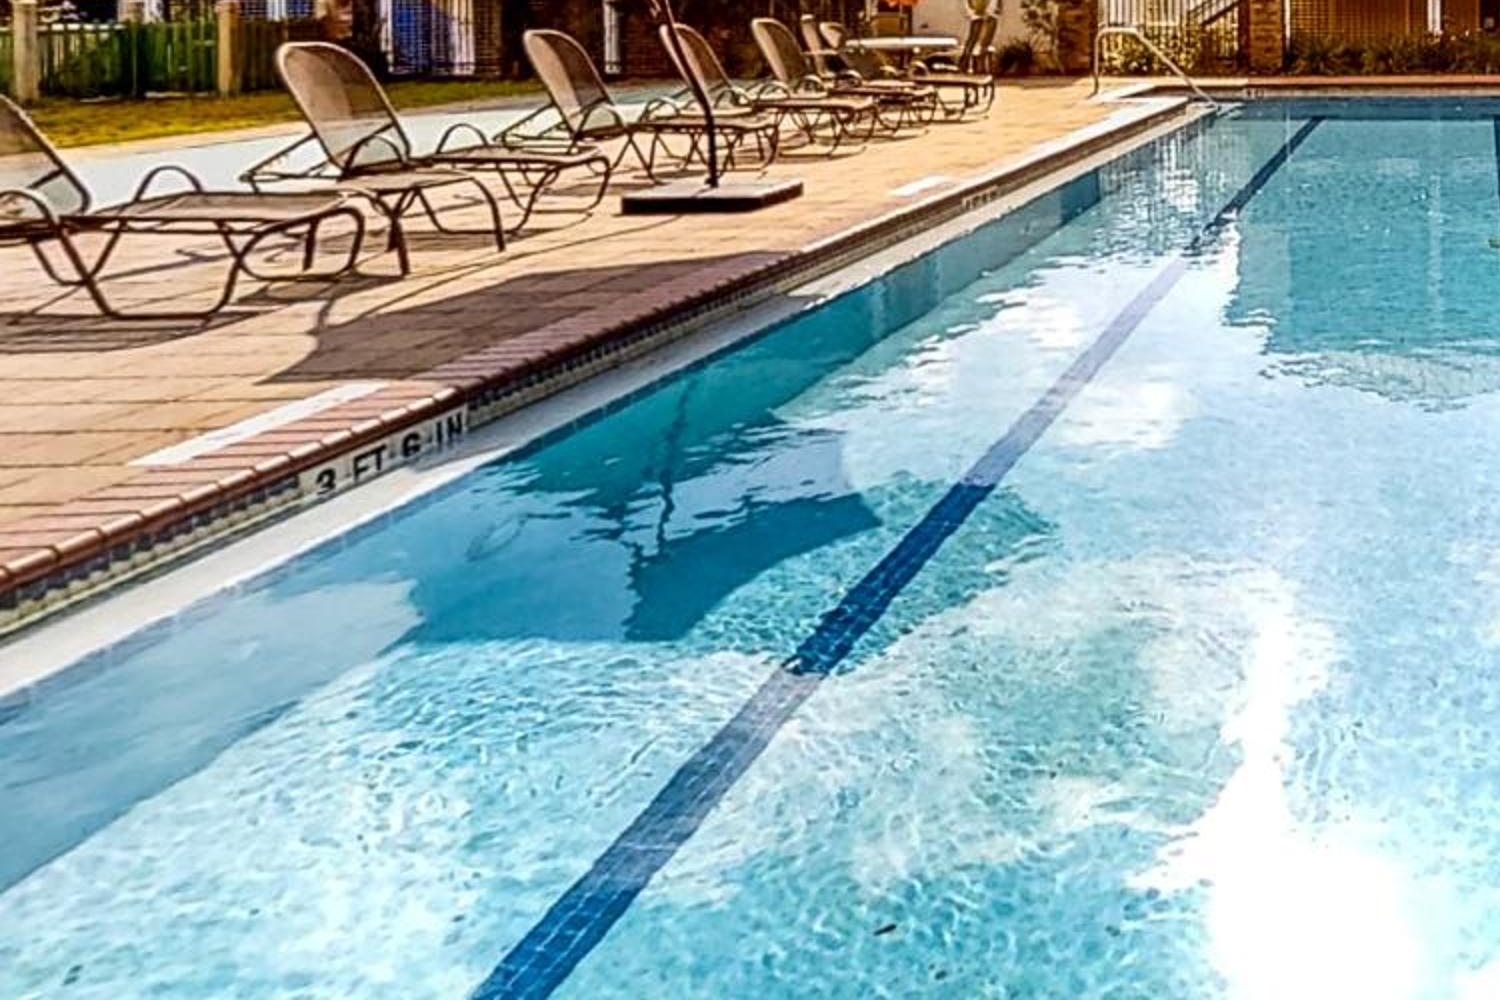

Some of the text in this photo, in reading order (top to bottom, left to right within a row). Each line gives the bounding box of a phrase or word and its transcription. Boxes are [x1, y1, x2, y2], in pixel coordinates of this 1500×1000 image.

[316, 467, 337, 496] 3
[352, 443, 387, 480] FT
[434, 411, 464, 444] IN
